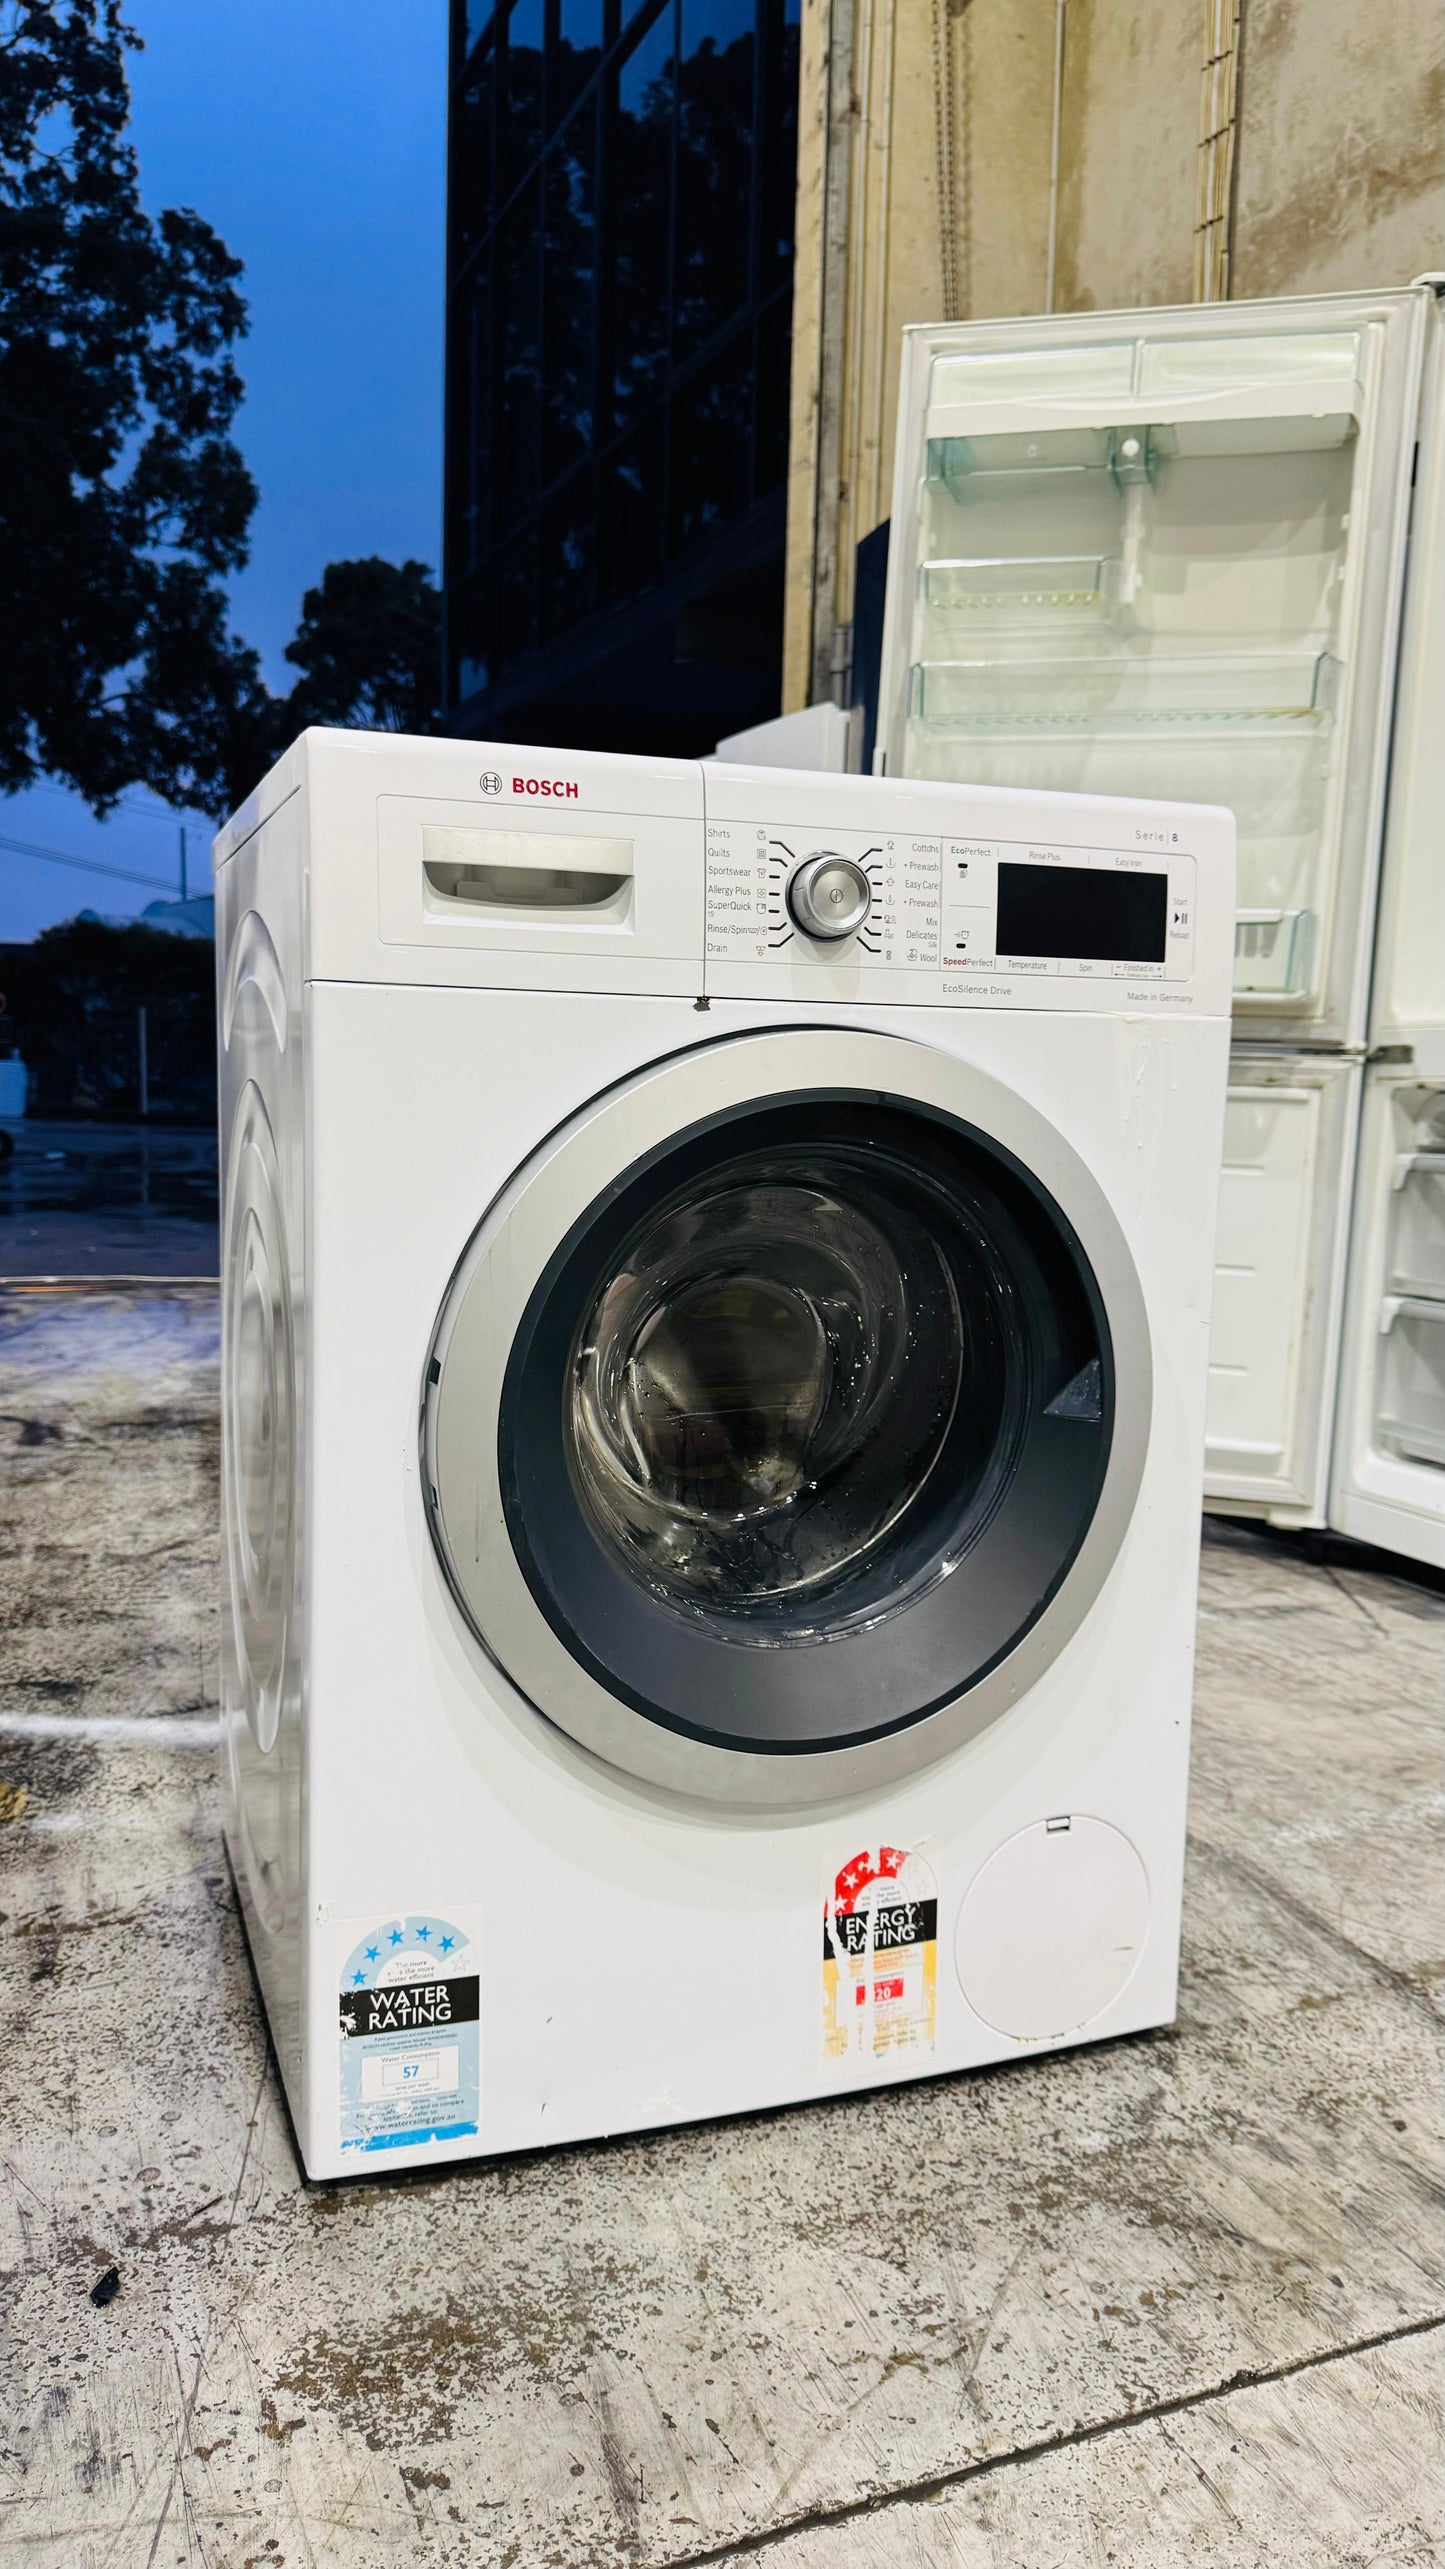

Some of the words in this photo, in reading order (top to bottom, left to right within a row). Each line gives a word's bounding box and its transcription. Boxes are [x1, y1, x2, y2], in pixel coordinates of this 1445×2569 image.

[512, 777, 579, 799] BOSCH
[708, 828, 730, 838] Shirts
[1135, 829, 1165, 842] Serie
[1171, 833, 1178, 842] 8
[708, 847, 730, 857] Quilts
[912, 843, 939, 853] Cottons
[950, 846, 992, 857] EcoPerfect
[708, 865, 751, 876] Sportswear
[910, 861, 939, 871] Prewash
[708, 885, 733, 896] Allergy
[735, 886, 751, 895] Plus
[905, 880, 921, 890] Easy
[923, 880, 939, 890] Care
[708, 899, 751, 911] SuperQuick
[909, 898, 939, 908] Prewash
[926, 917, 938, 926] Mix
[707, 924, 748, 935] Rinse/Spin
[906, 930, 938, 940] Delicates
[707, 943, 728, 952] Drain
[920, 953, 938, 962] Wool
[943, 957, 993, 968] SpeedPerfect
[1008, 959, 1048, 970] Temperature
[942, 983, 989, 995] EcoSilence
[990, 986, 1012, 996] Drive
[1127, 991, 1148, 1001] Made
[1150, 993, 1158, 1001] in
[1159, 993, 1194, 1005] Germany
[847, 1925, 916, 1952] RATING
[370, 1985, 450, 2011] WATER
[368, 2003, 452, 2030] RATING
[403, 2064, 420, 2079] 57
